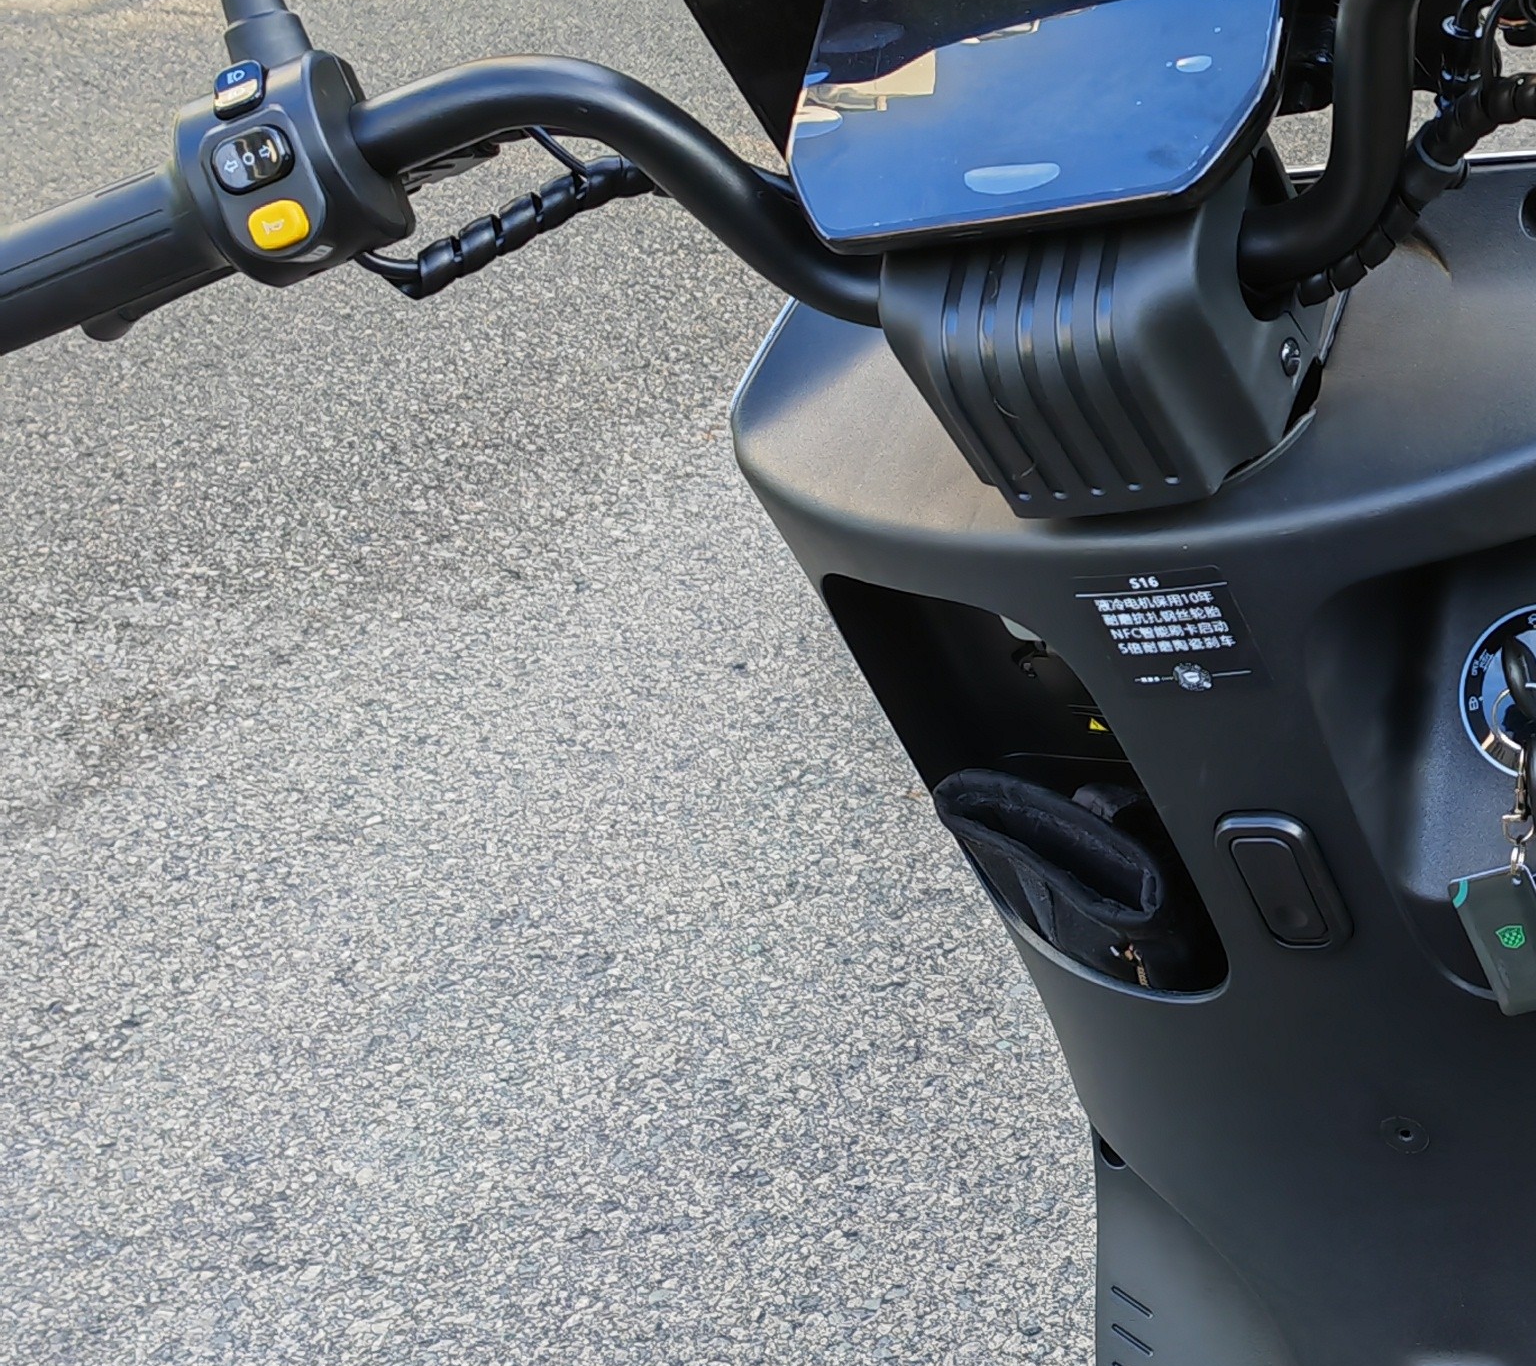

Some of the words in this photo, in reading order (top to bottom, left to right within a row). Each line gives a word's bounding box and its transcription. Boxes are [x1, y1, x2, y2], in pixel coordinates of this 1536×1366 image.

[1129, 576, 1160, 590] S16
[1094, 591, 1214, 612] 液冷电机保用10年
[1102, 606, 1222, 626] 耐磨抗扎钢丝轮胎
[1110, 620, 1230, 640] NFC智能刷卡启动
[1117, 635, 1236, 655] 5倍耐磨陶瓷刹车
